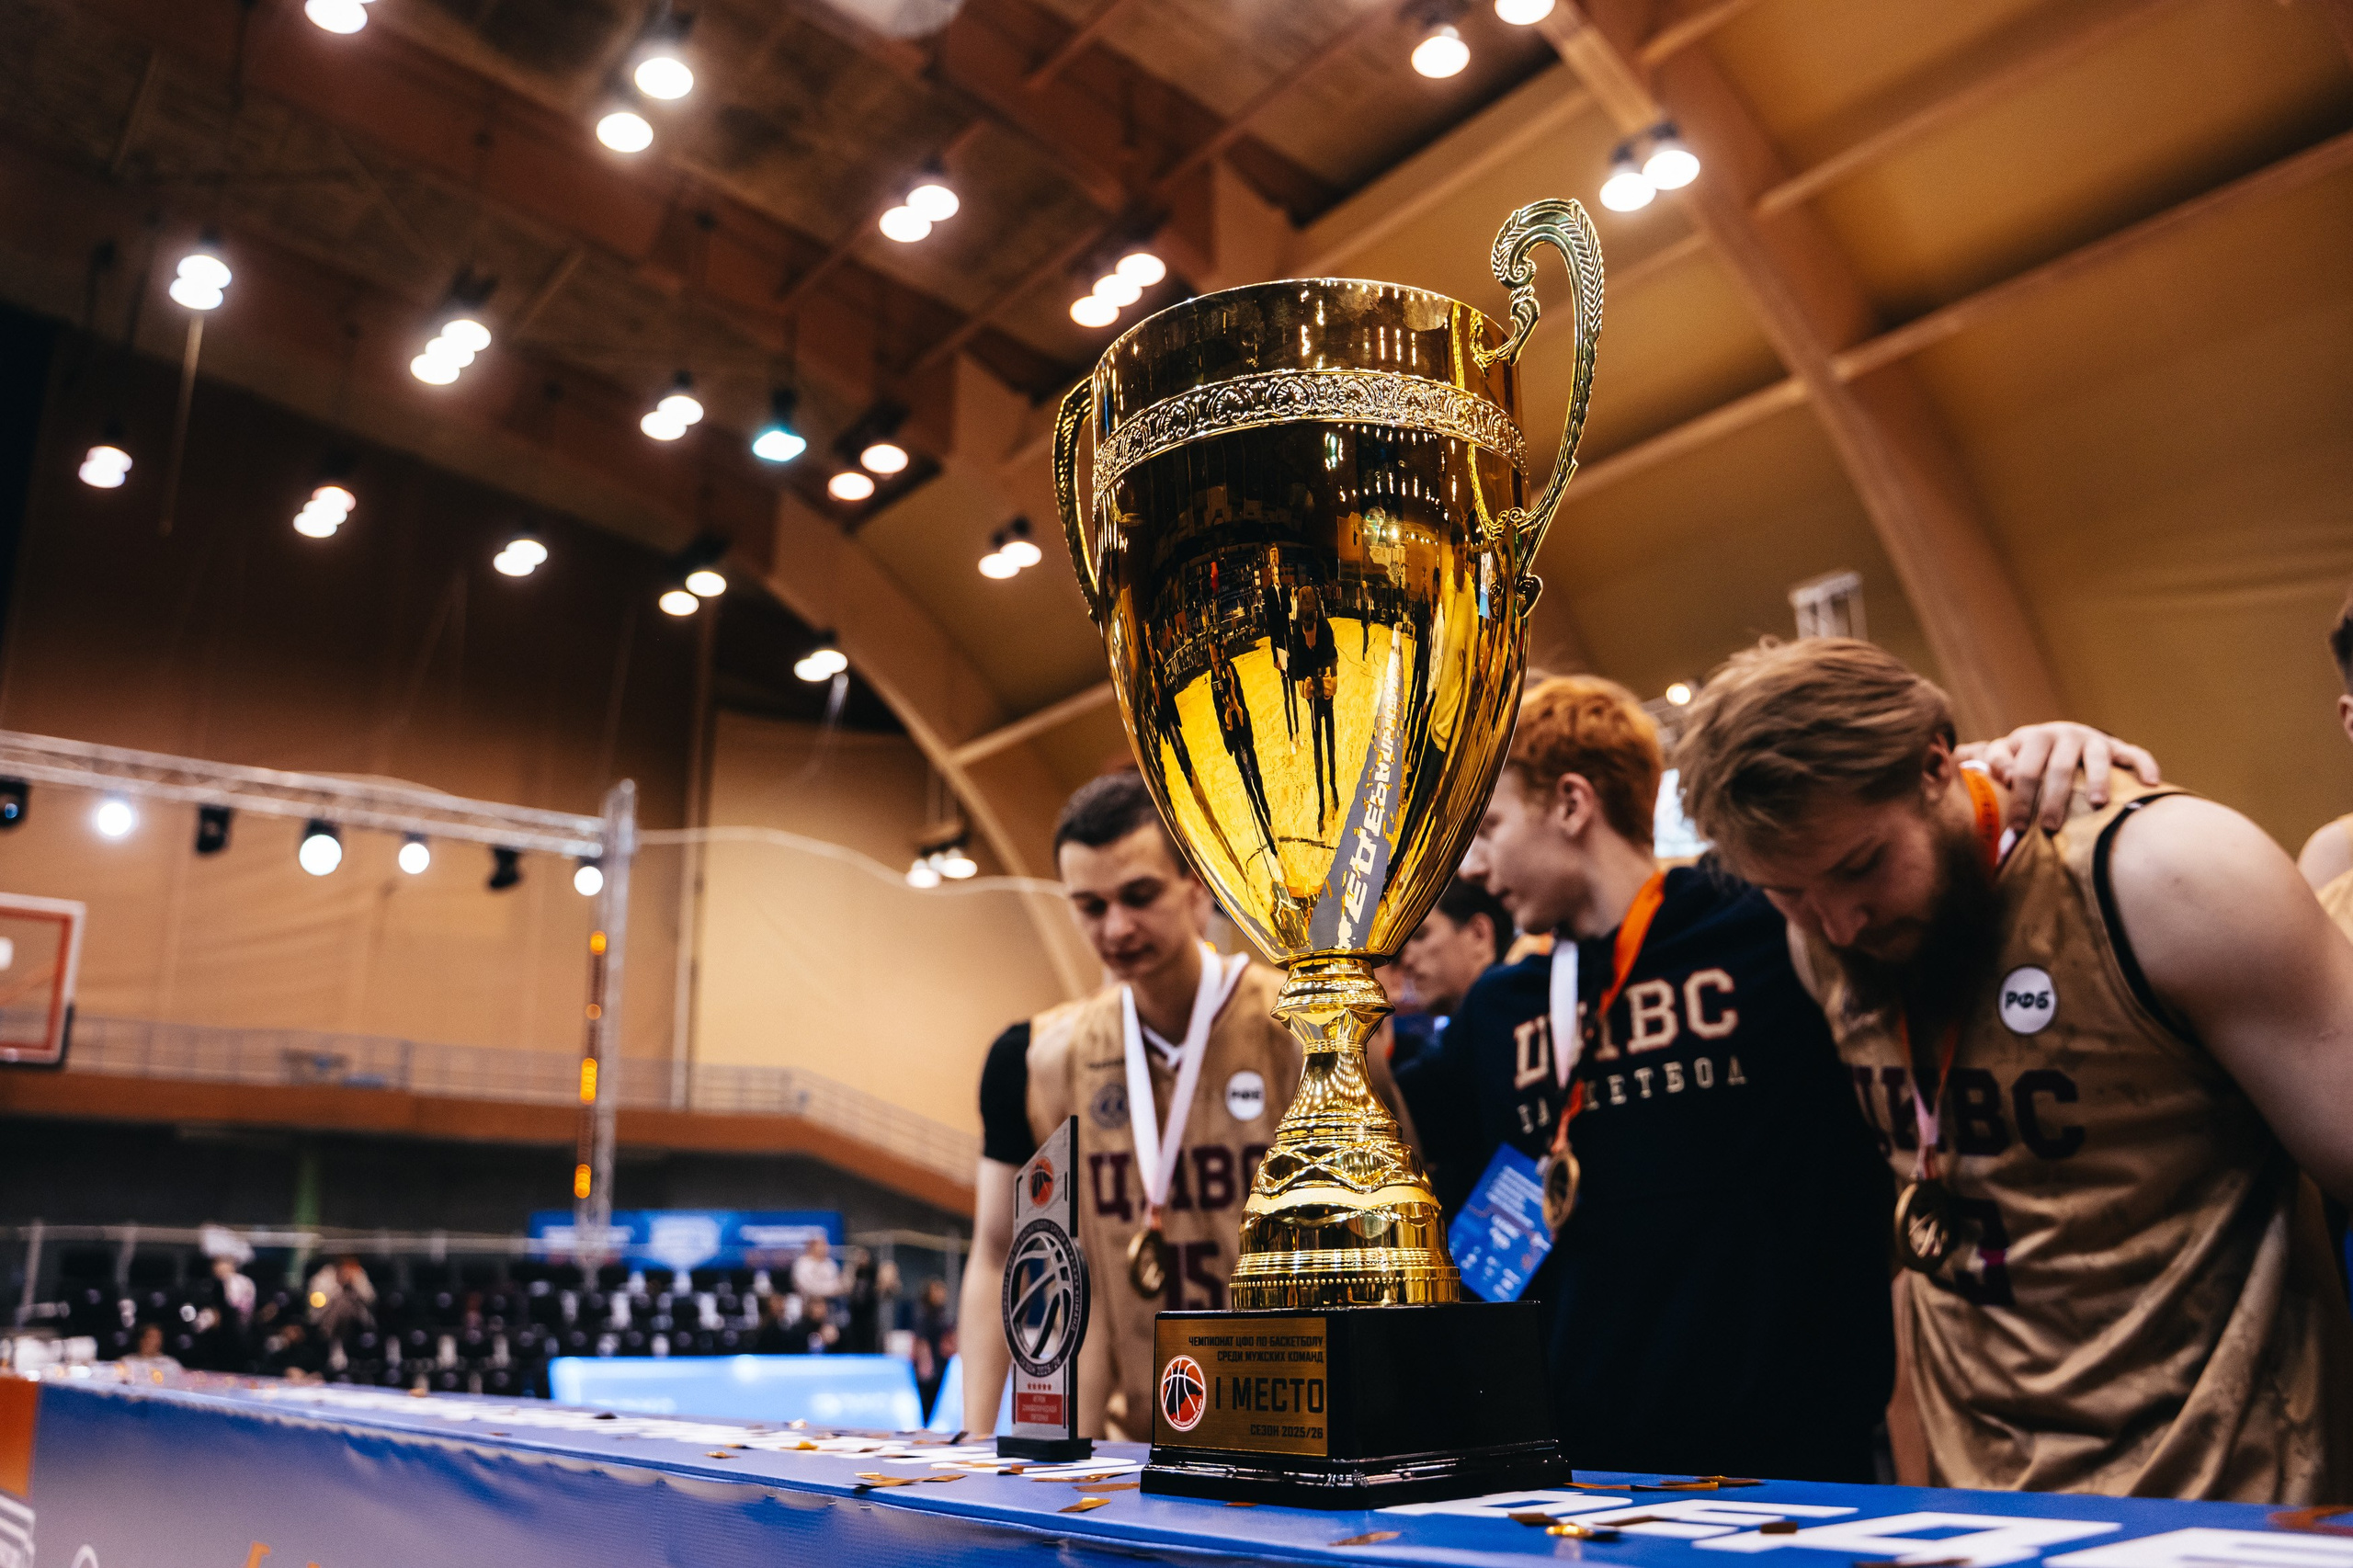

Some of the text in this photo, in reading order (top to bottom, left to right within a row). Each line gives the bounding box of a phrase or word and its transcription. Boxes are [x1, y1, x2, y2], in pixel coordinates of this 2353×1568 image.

[1188, 1335, 1324, 1347] ЧЕМПИОНАТ ЦФО ПО БАСКЕТБОЛУ
[1217, 1351, 1324, 1363] СРЕДИ МУЖСКИХ КОМАНД
[1215, 1377, 1221, 1409] I
[1232, 1377, 1324, 1414] МЕСТО
[1250, 1424, 1324, 1439] СЕЗОН 2025/26
